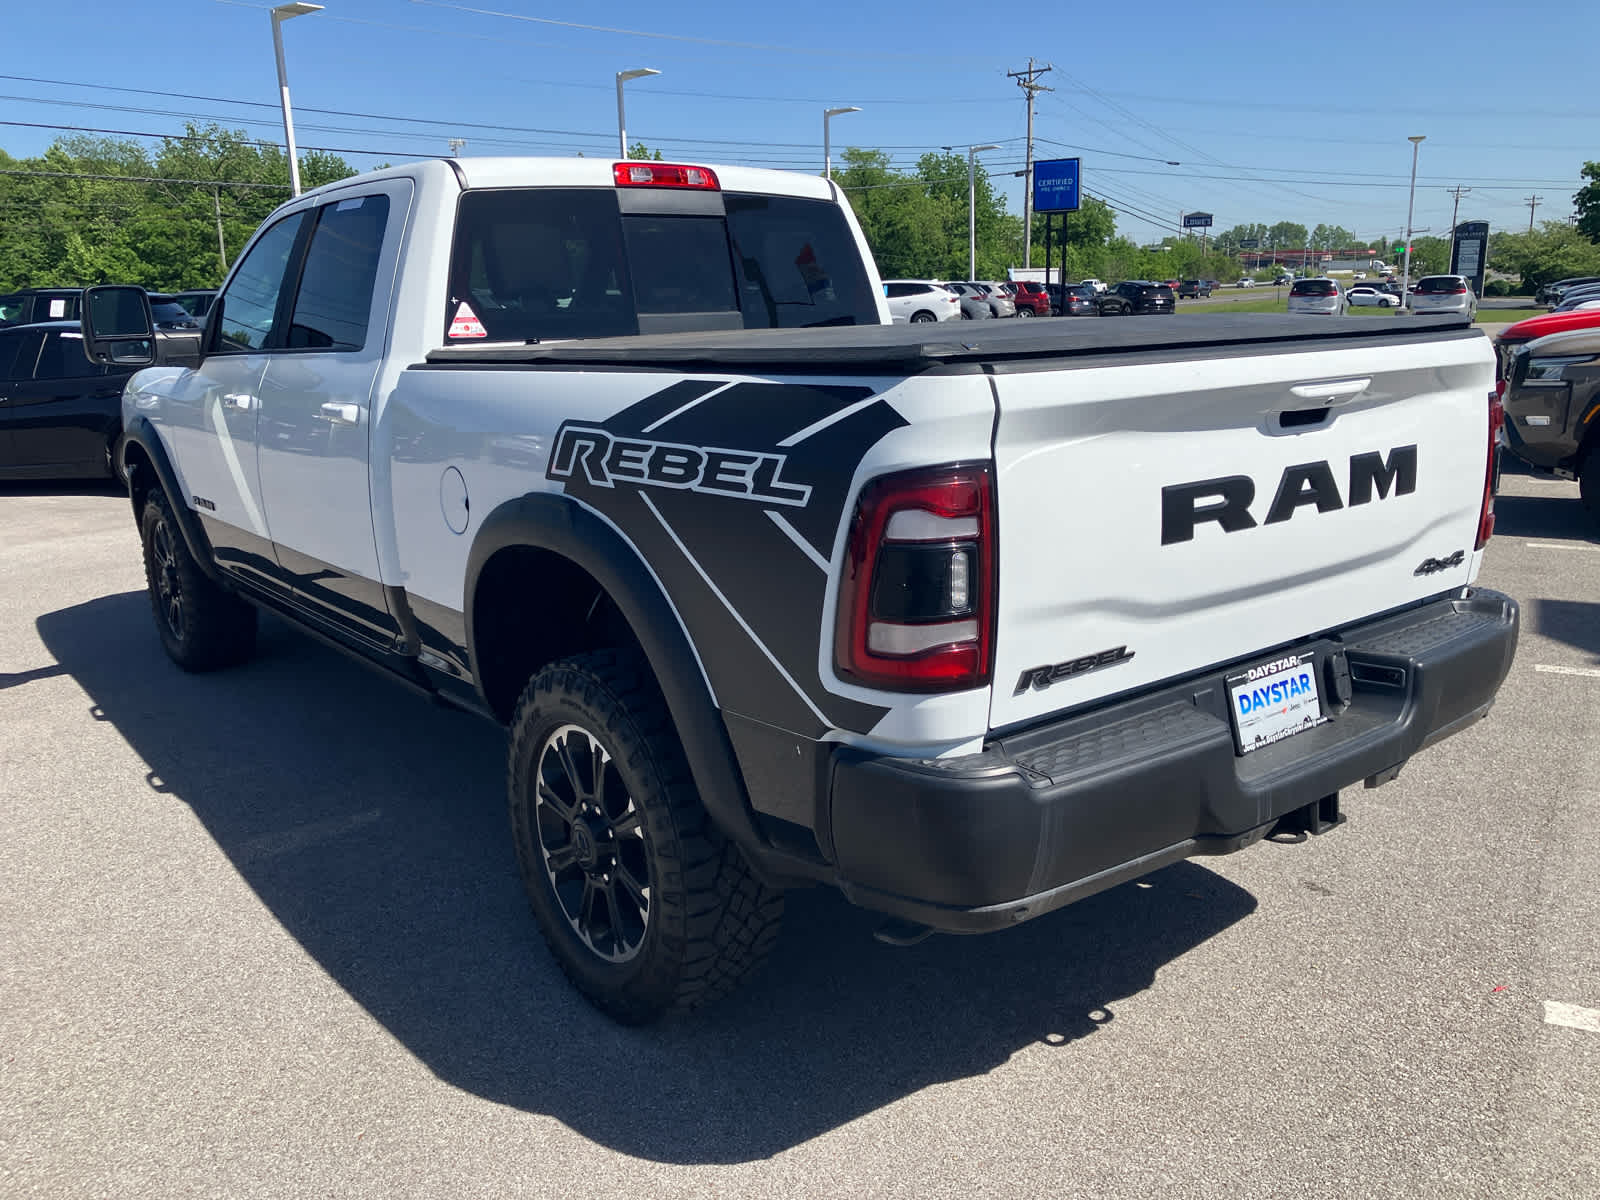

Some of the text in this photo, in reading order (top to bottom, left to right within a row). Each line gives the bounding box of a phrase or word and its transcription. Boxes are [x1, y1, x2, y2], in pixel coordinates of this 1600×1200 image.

[1038, 178, 1073, 187] CERTIFIED
[549, 424, 814, 508] REBEL
[1161, 444, 1418, 546] RAM
[1012, 645, 1136, 697] REBEL
[1248, 656, 1297, 681] DAYSTAR
[1239, 673, 1311, 714] DAYSTAR
